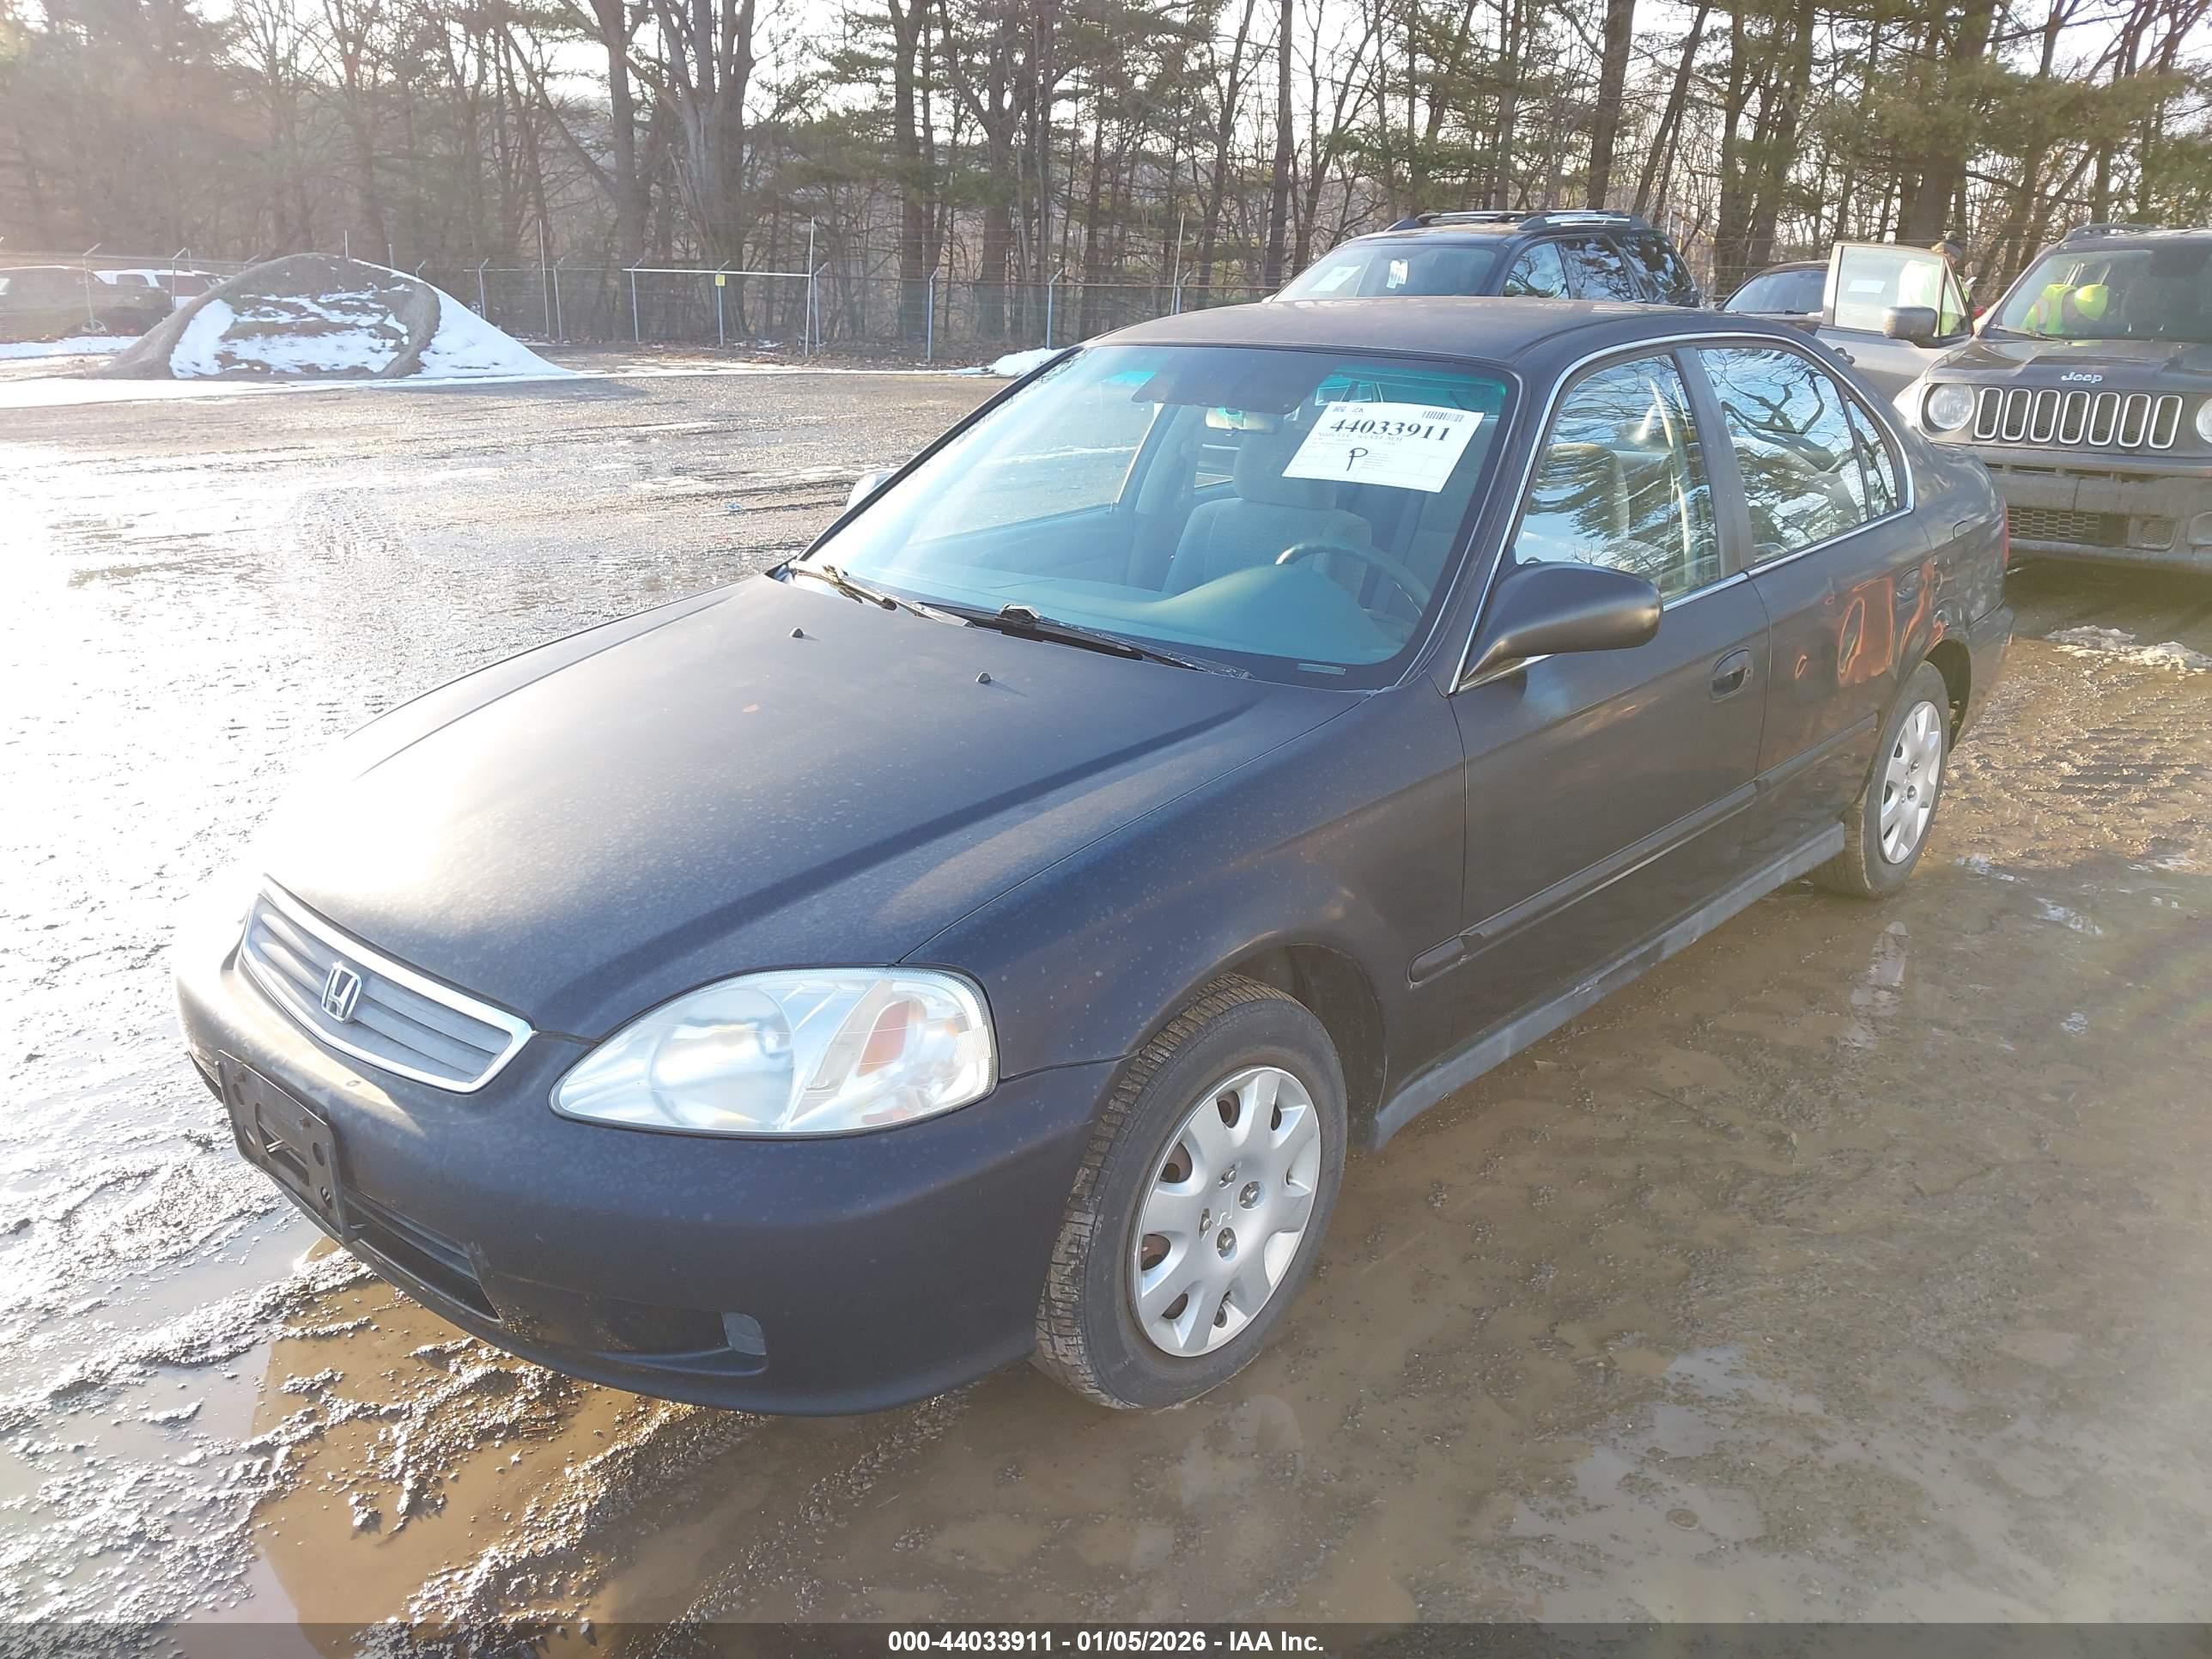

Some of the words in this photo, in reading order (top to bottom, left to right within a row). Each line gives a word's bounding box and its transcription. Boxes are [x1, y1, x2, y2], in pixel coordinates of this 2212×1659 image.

[2061, 372, 2103, 384] Jeep
[1330, 418, 1450, 441] 44033911
[1346, 447, 1369, 471] P
